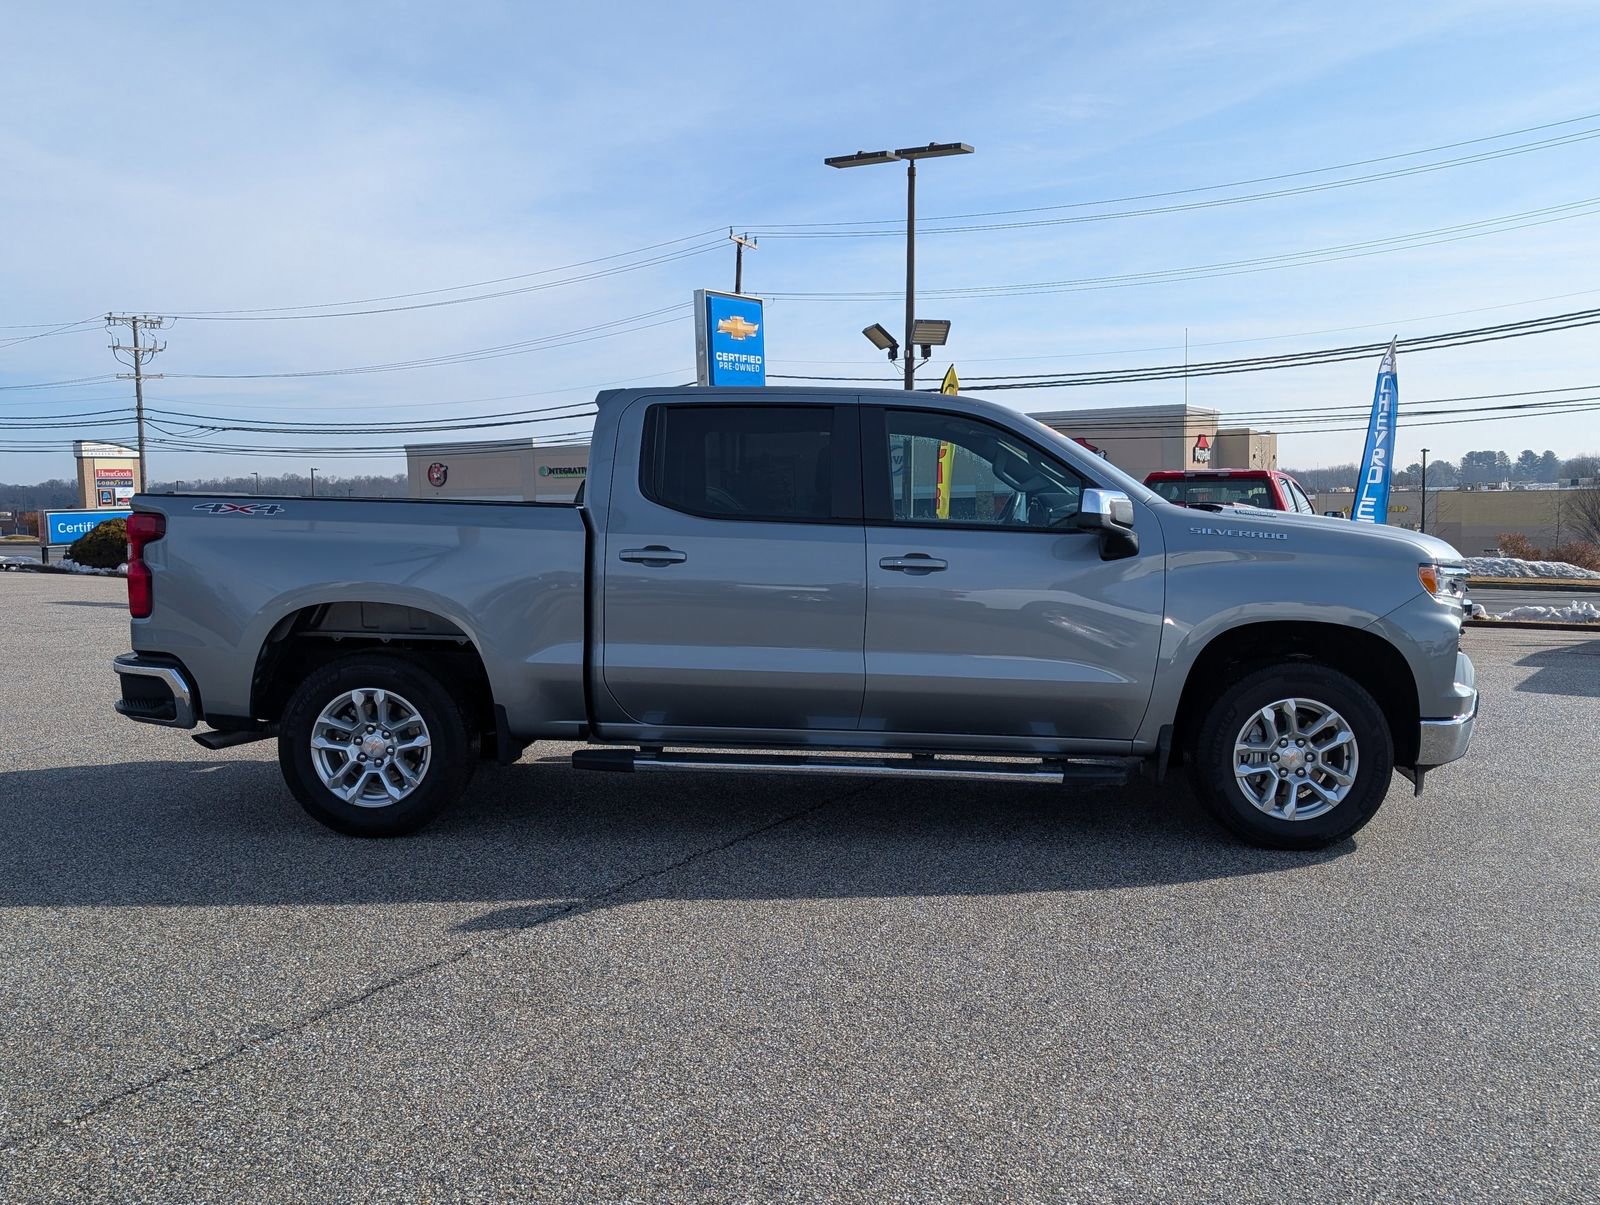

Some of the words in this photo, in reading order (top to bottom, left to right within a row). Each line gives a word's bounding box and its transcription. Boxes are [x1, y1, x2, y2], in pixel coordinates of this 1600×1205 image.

[716, 352, 762, 364] CERTIFIED
[719, 362, 760, 373] PRE-OWNED
[1190, 527, 1288, 540] SILVERADO
